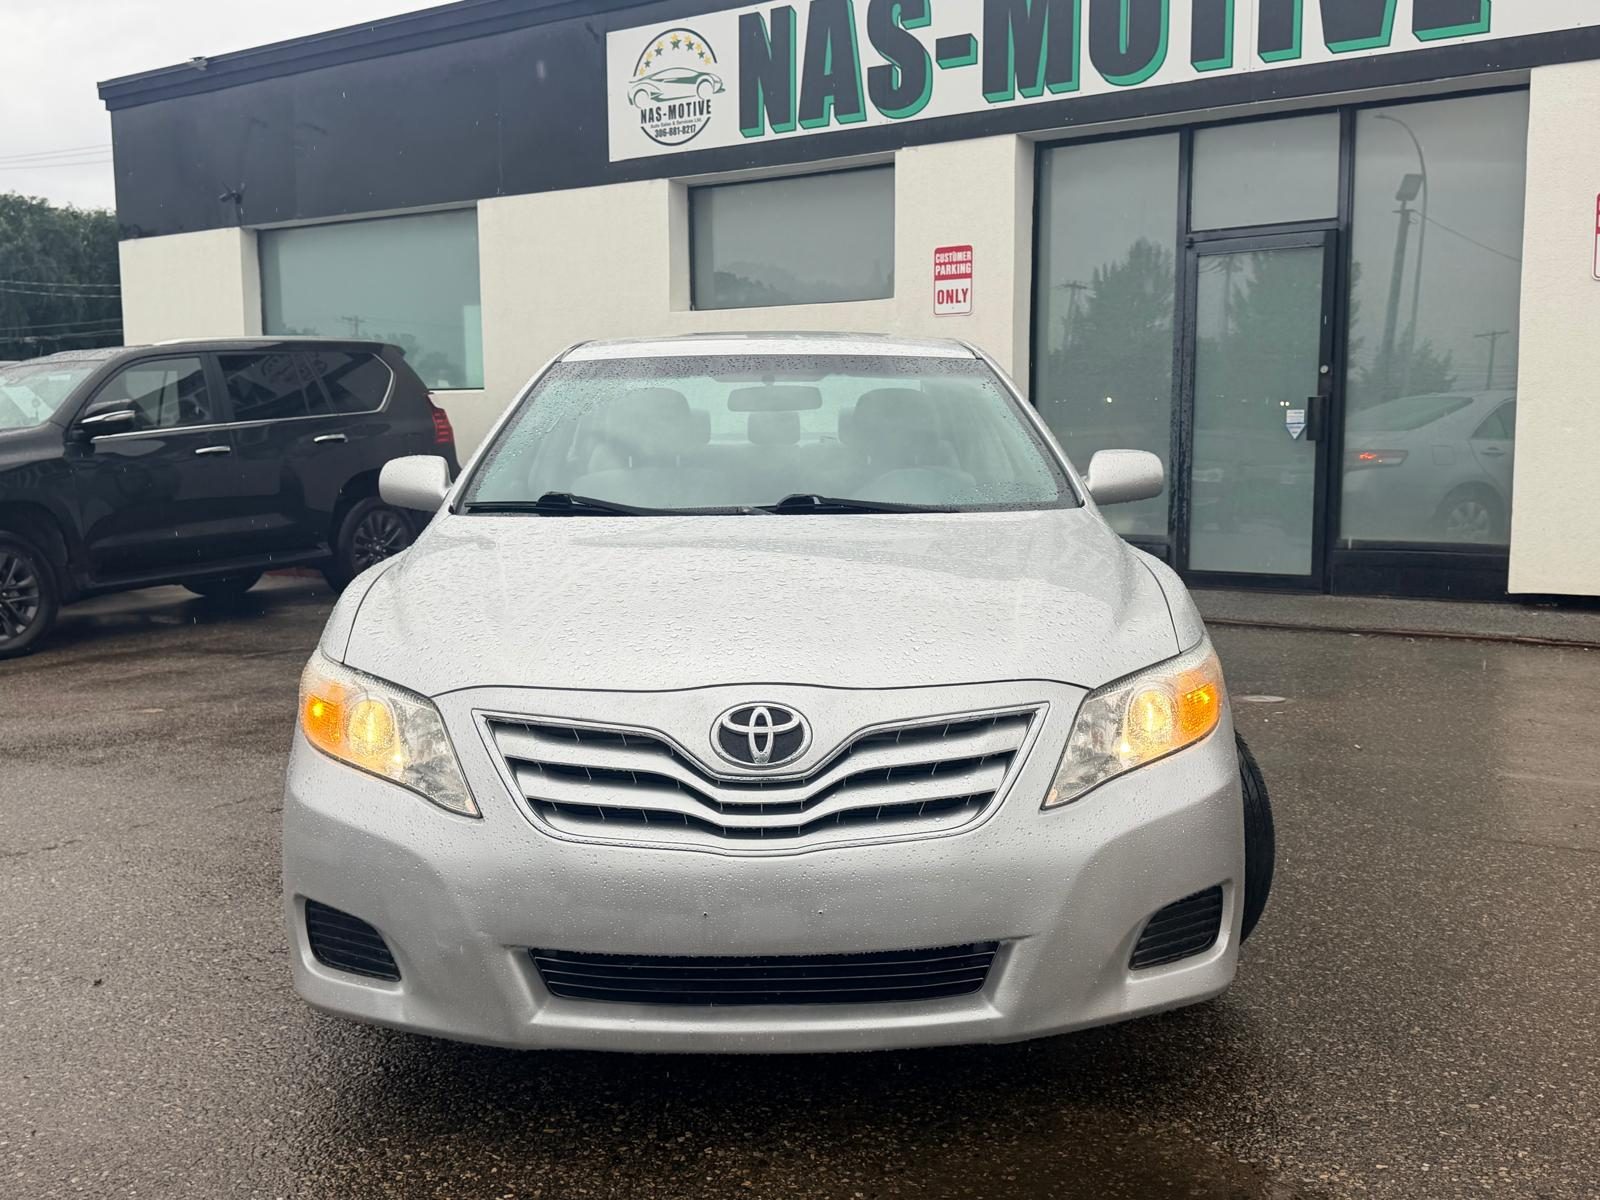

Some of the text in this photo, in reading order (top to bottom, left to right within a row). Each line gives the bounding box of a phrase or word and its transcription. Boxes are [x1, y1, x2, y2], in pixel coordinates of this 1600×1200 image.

[641, 99, 711, 124] NAS-MOTIVE
[935, 251, 971, 263] CUSTOMER
[935, 262, 972, 276] PARKING
[937, 288, 969, 305] ONLY
